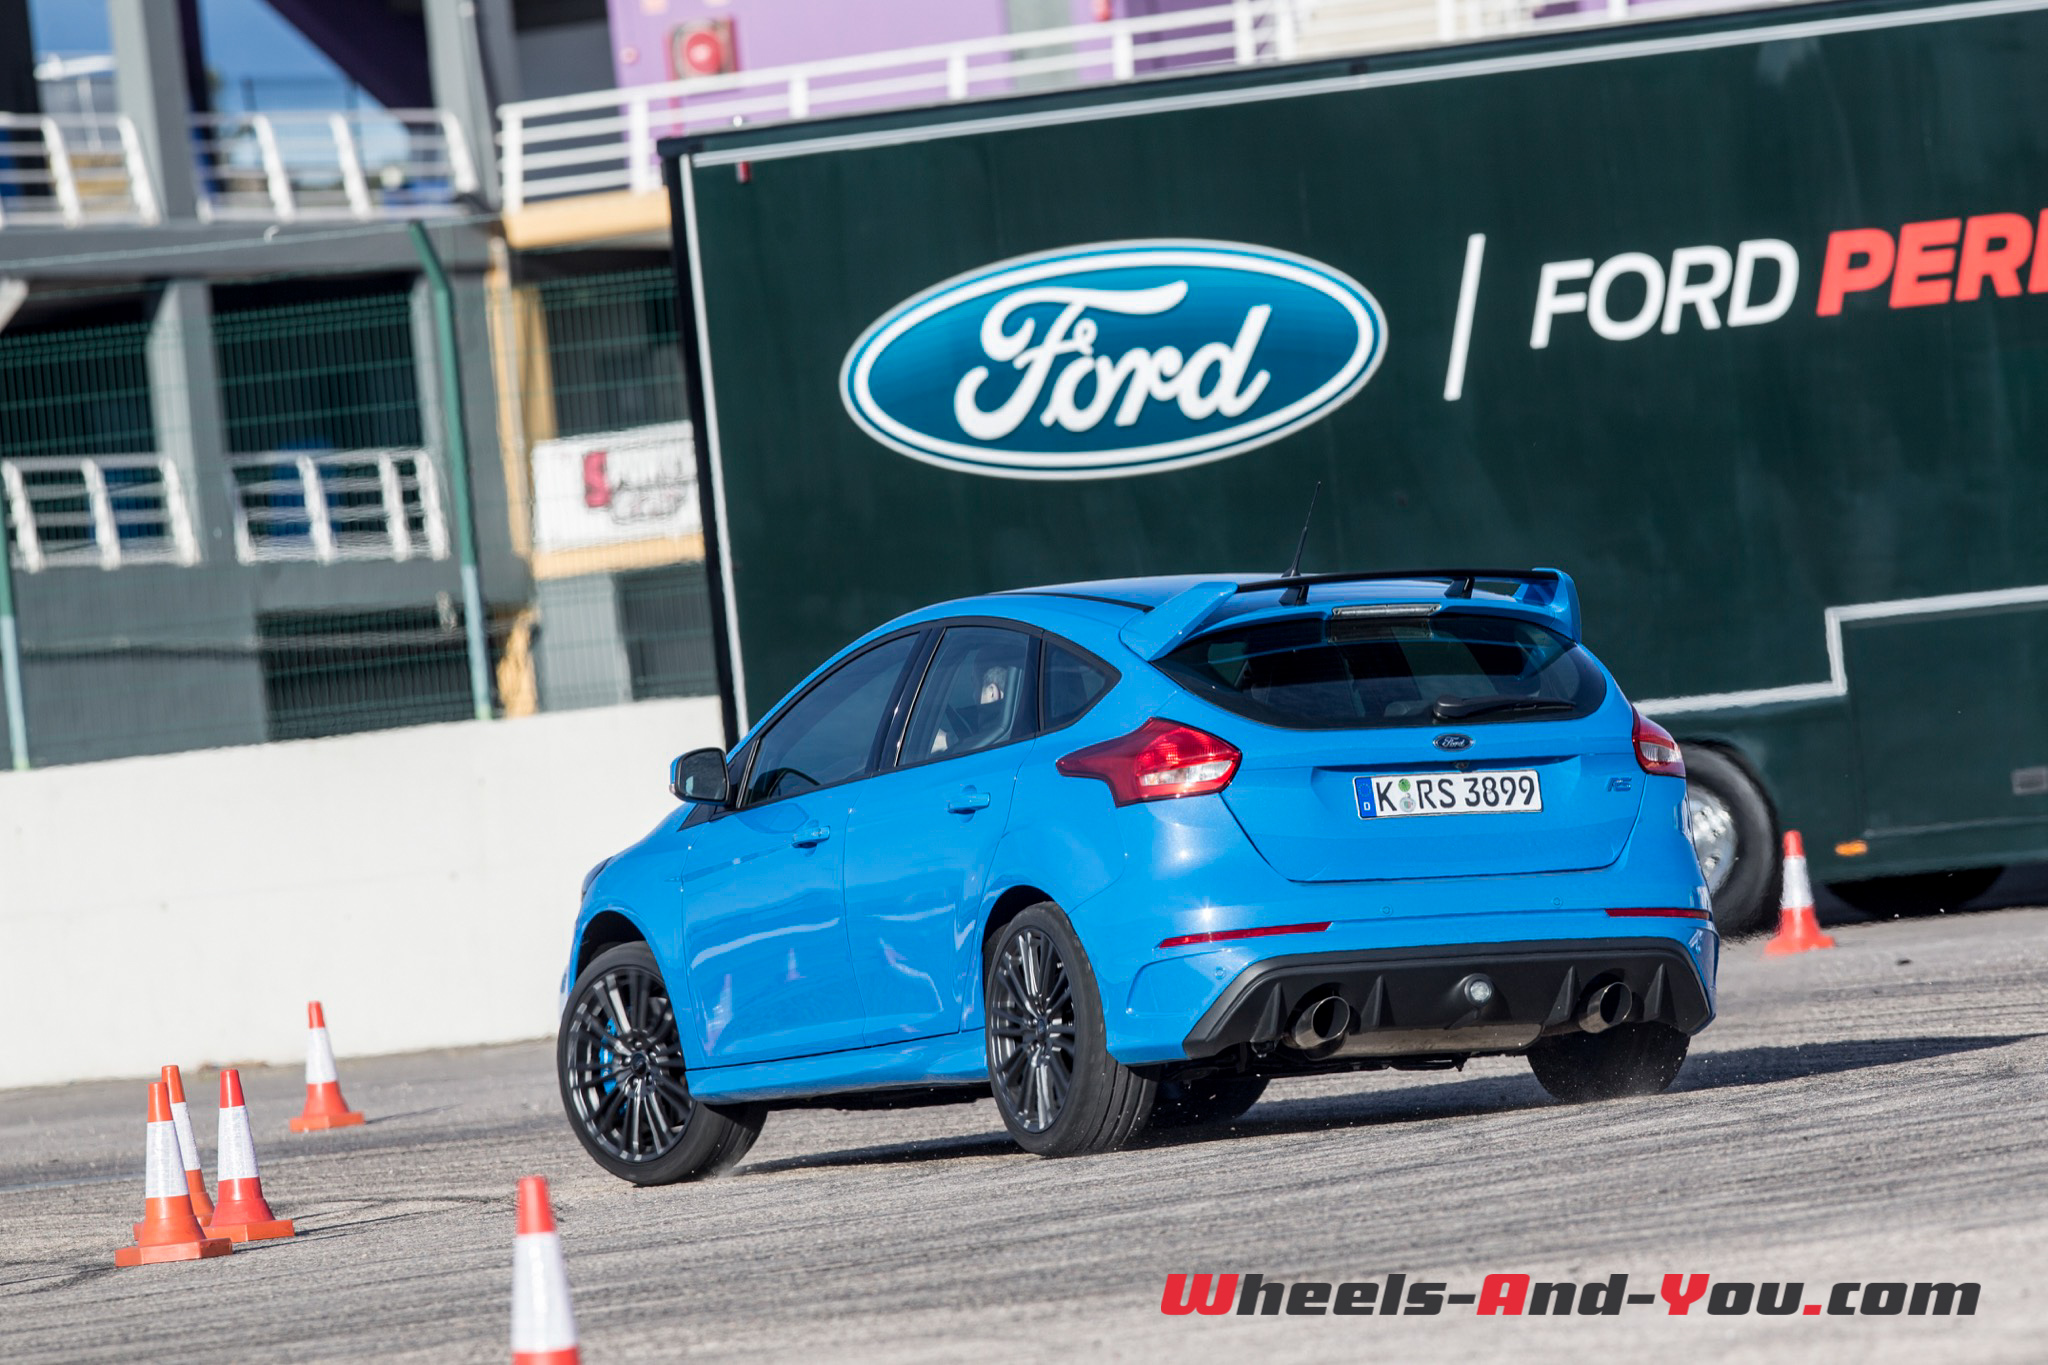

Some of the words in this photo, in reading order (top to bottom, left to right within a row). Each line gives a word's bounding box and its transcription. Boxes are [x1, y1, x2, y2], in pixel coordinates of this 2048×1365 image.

[1529, 238, 1800, 349] FORD
[1815, 208, 2048, 317] PER
[954, 279, 1272, 440] Ford
[1441, 735, 1466, 748] Ford
[1363, 801, 1371, 811] D
[1463, 775, 1536, 808] 3899
